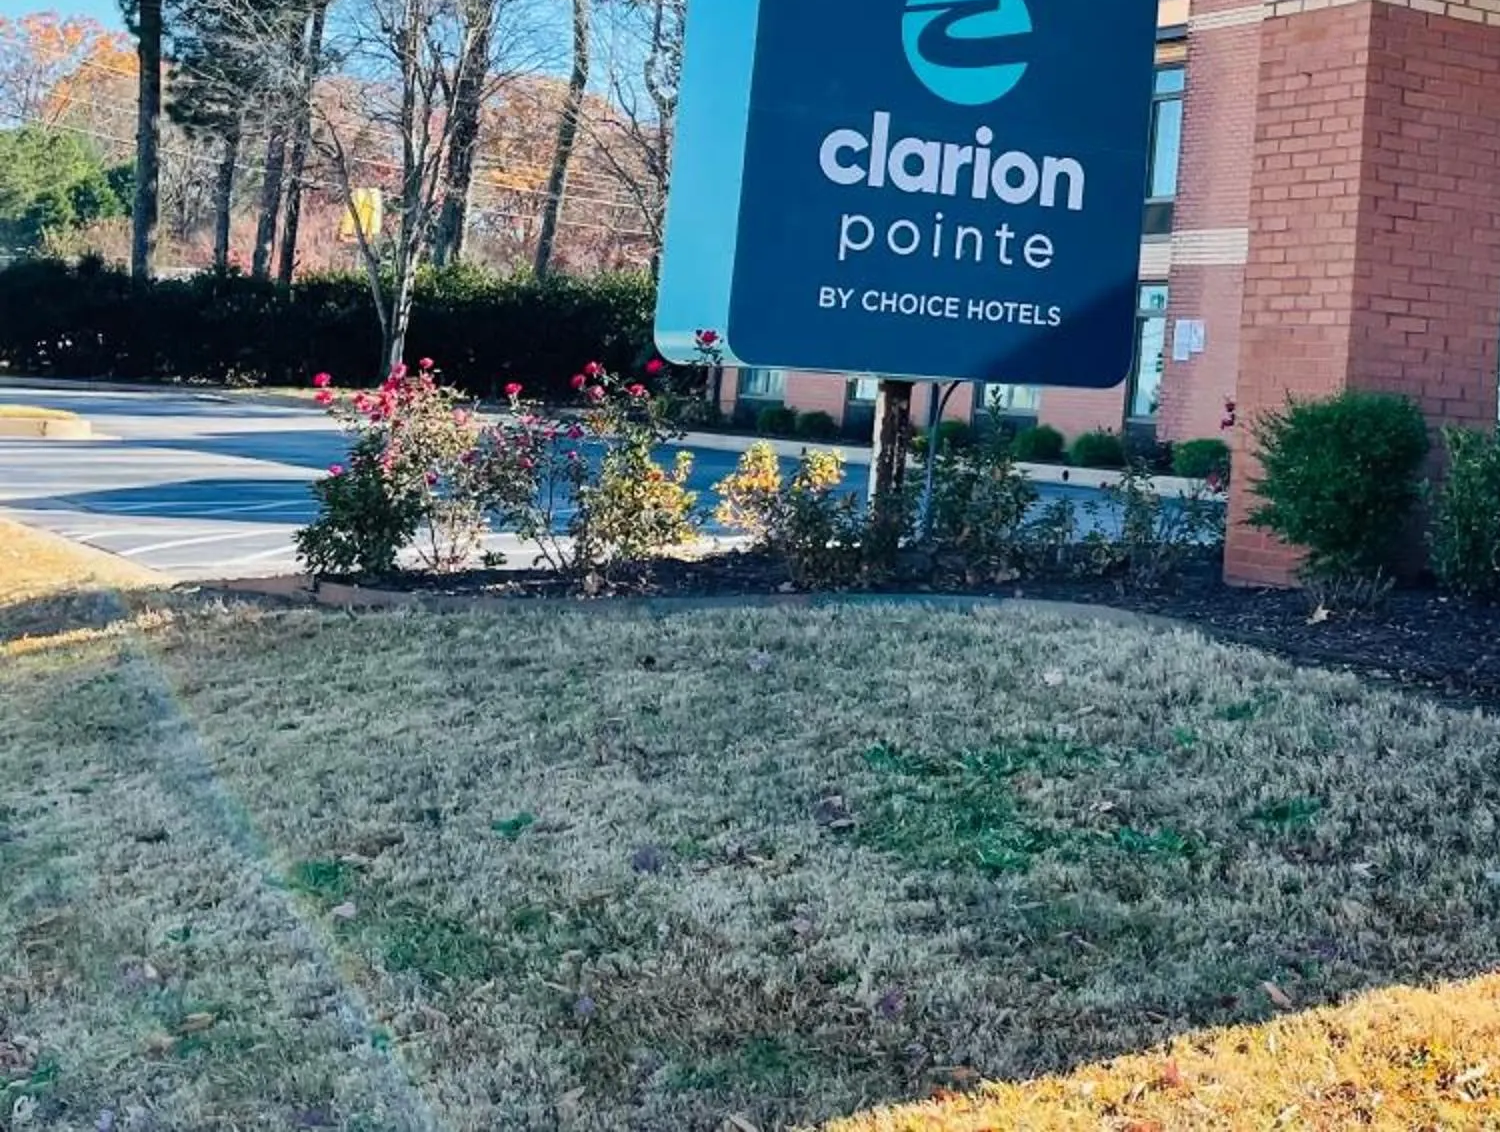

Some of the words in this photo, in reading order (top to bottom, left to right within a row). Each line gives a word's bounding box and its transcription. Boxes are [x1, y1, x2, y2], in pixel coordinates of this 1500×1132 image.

[819, 111, 1085, 210] clarion
[838, 212, 1055, 269] pointe
[818, 286, 855, 309] BY
[861, 290, 960, 318] CHOICE
[966, 299, 1062, 326] HOTELS
